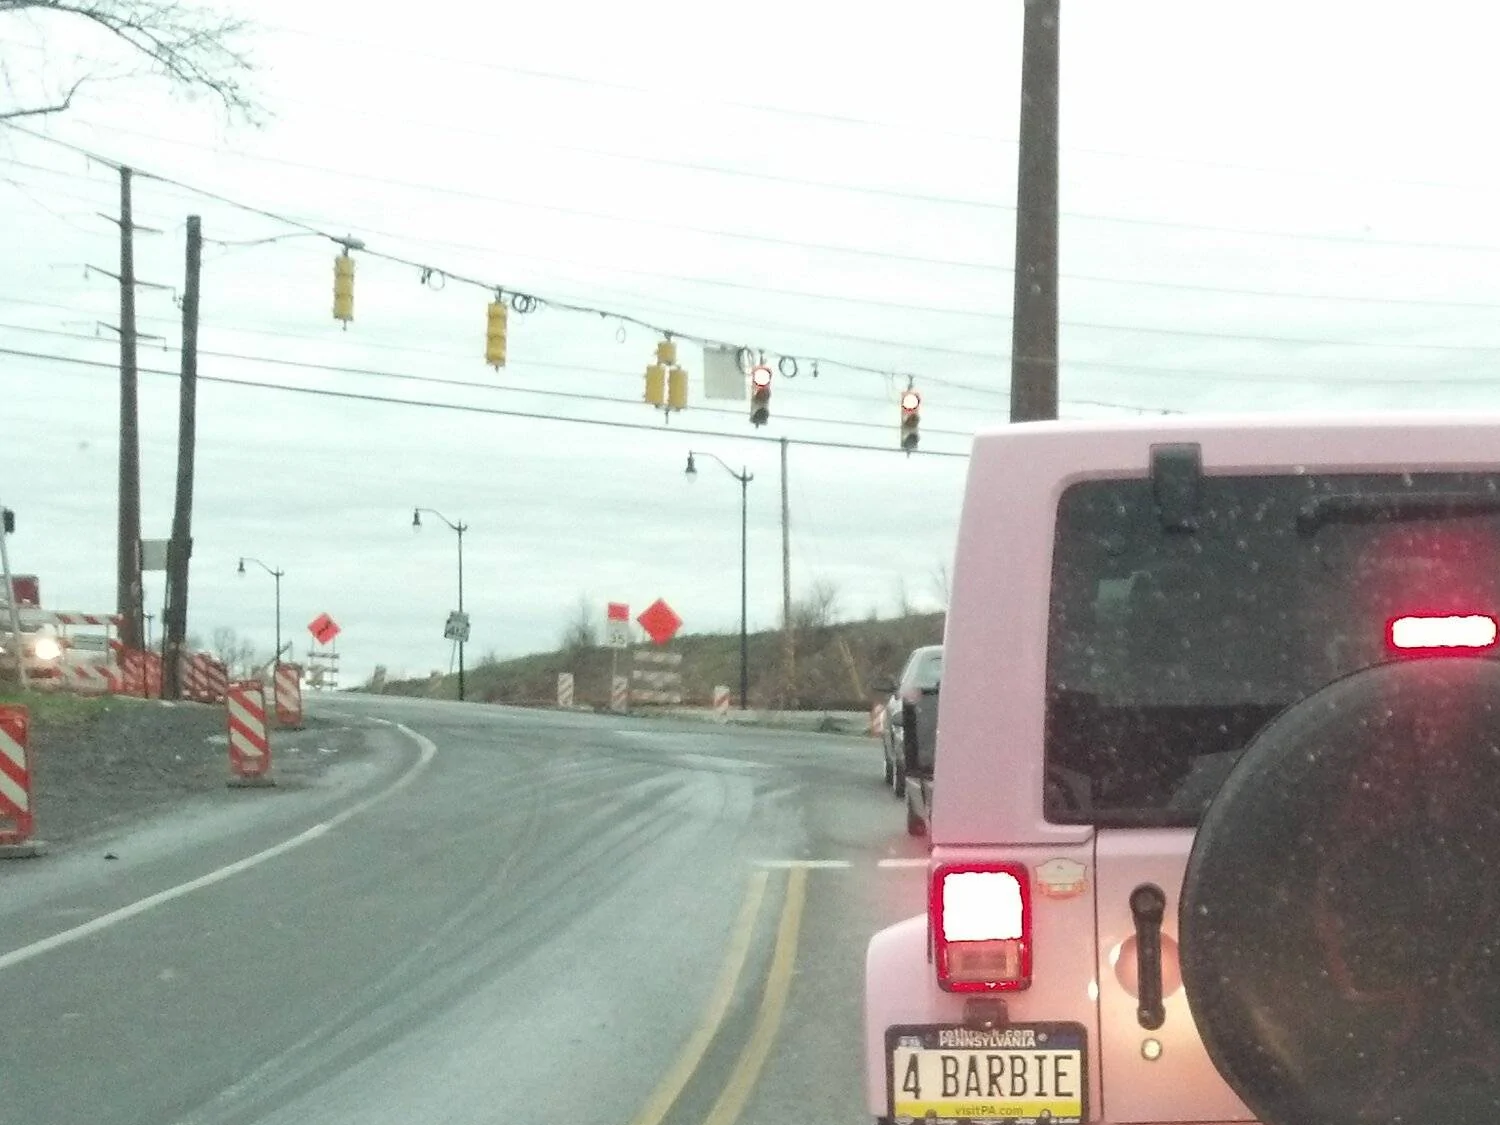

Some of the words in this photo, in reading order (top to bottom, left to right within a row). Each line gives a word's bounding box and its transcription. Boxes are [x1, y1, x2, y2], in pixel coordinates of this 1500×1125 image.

[939, 1036, 1037, 1047] PENNSYLVANIA
[902, 1053, 921, 1099] 4
[941, 1054, 1074, 1098] BARBIE
